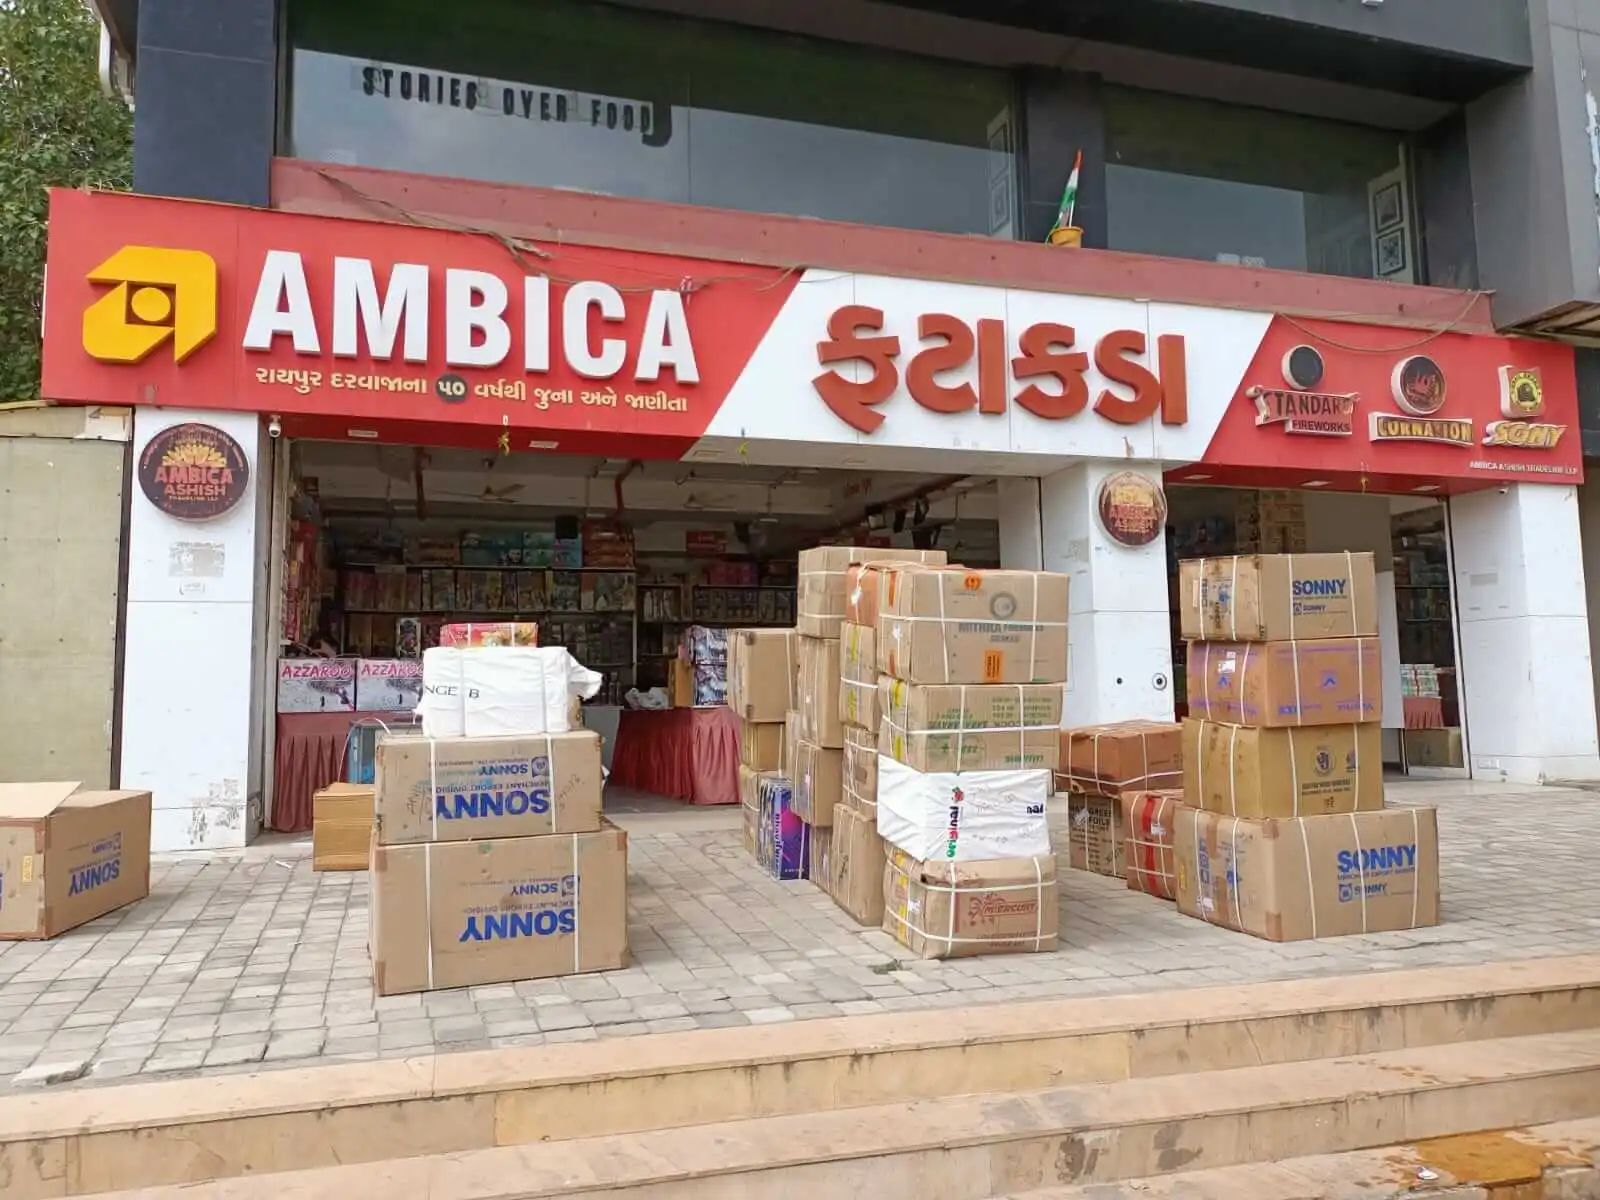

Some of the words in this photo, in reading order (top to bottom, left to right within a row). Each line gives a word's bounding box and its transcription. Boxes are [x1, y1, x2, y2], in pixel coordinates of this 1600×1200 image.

[362, 66, 478, 111] STORIES
[503, 87, 567, 122] OVER
[591, 99, 651, 134] FOOD
[242, 249, 700, 385] AMBICA
[811, 304, 1188, 434] ફટાકડા
[255, 366, 323, 394] રાયપુર
[331, 372, 428, 394] દરવાજાના
[438, 380, 466, 396] ૫૦
[474, 378, 526, 401] વર્ષથી
[533, 387, 574, 409] જુના
[580, 386, 618, 408] અને
[624, 390, 689, 412] જાણીતા
[1291, 419, 1351, 433] FIREWORKS
[154, 465, 234, 484] AMBICA
[164, 483, 226, 497] ASHISH
[1292, 579, 1347, 596] SONNY
[281, 663, 353, 680] AZZAROO
[479, 763, 529, 777] SONNY
[434, 789, 551, 820] SONNY
[1337, 844, 1416, 873] SONNY
[67, 859, 121, 899] SONNY
[510, 883, 559, 896] SONNY
[459, 908, 576, 943] SONNY
